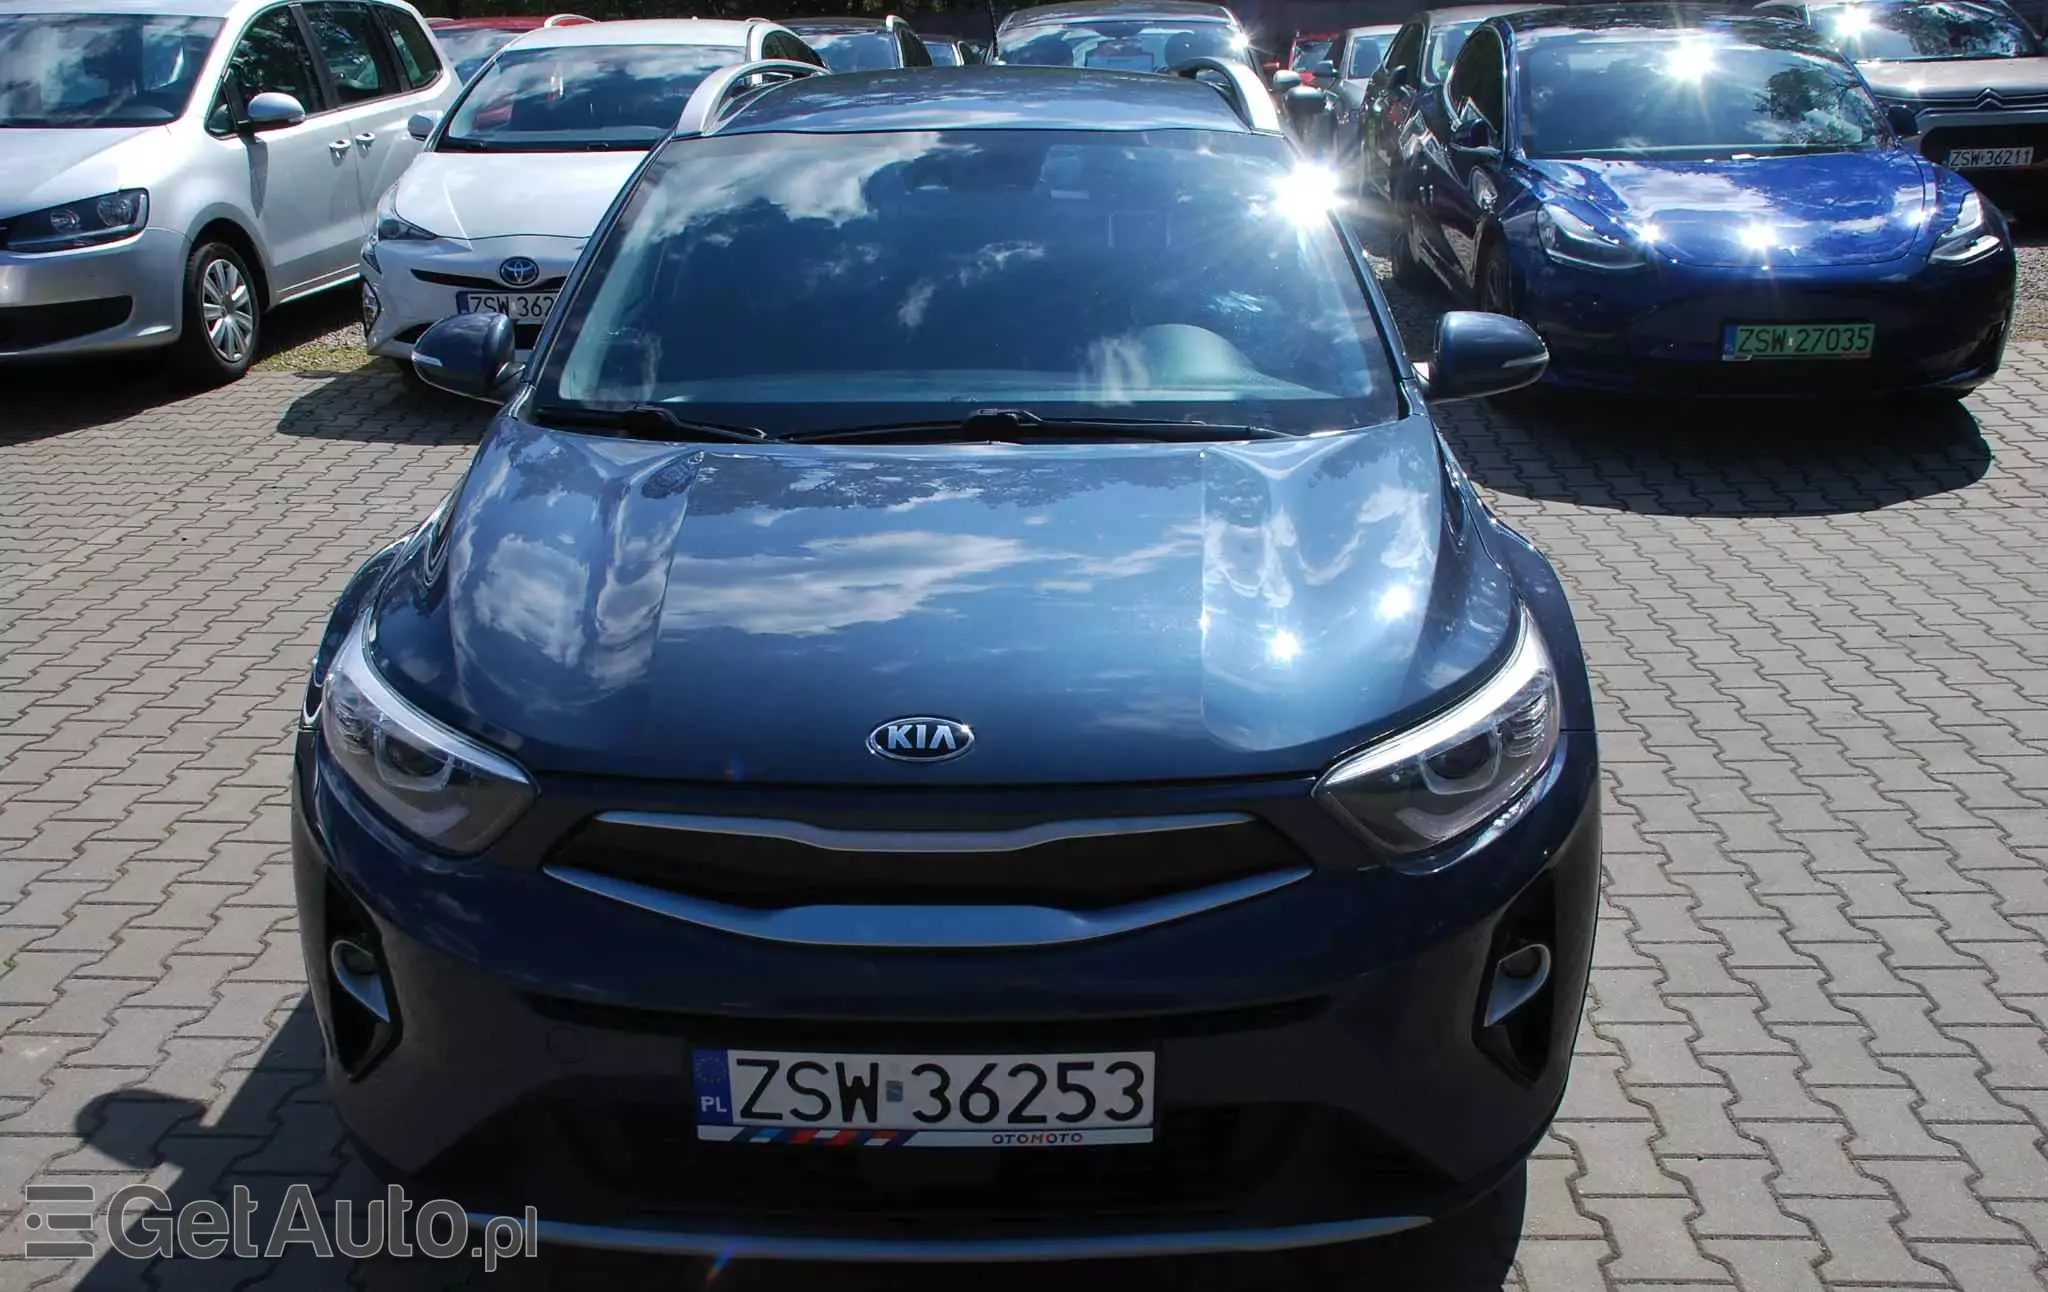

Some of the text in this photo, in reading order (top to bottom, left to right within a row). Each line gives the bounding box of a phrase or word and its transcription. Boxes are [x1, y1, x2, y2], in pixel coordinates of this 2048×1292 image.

[1950, 150, 2030, 166] ZSW 36211
[1738, 326, 1871, 353] ZSW 27035
[887, 724, 957, 749] KIA
[735, 1058, 1145, 1125] ZSW 36253
[700, 1096, 728, 1113] PL
[992, 1132, 1084, 1146] OTOMOTO
